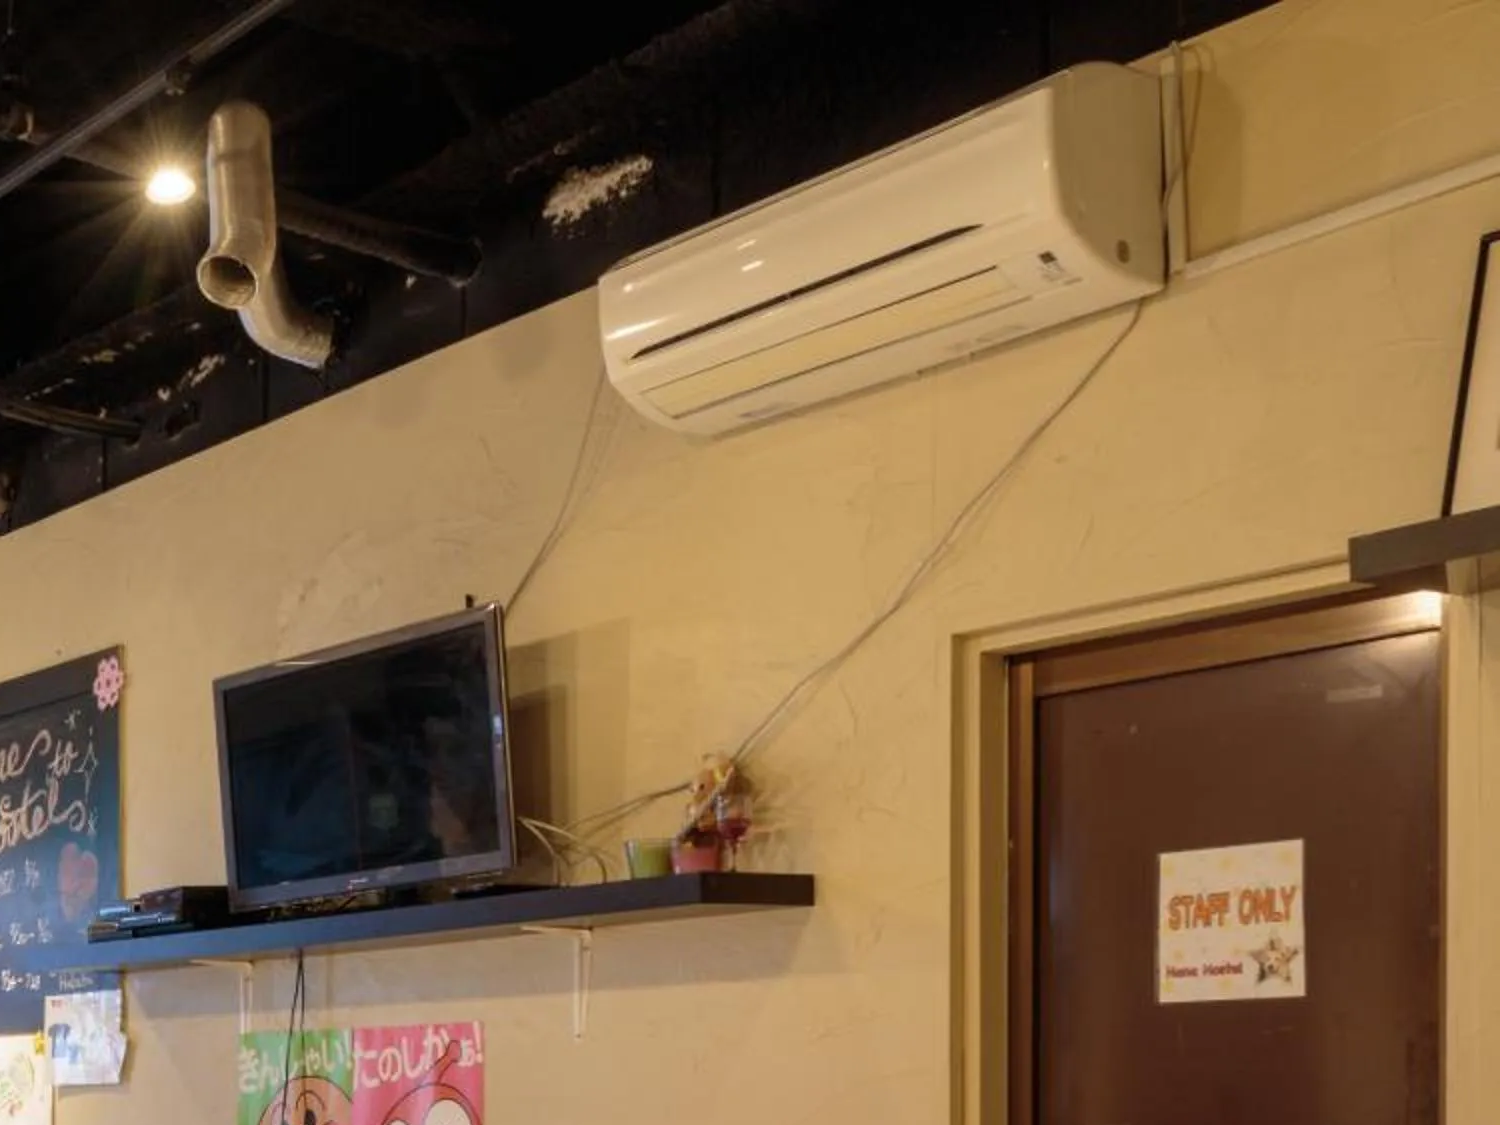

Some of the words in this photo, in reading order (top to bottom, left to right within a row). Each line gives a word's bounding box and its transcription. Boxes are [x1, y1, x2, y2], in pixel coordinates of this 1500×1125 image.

[50, 740, 78, 778] to
[1167, 890, 1231, 931] STAFF
[1237, 884, 1297, 926] ONLY
